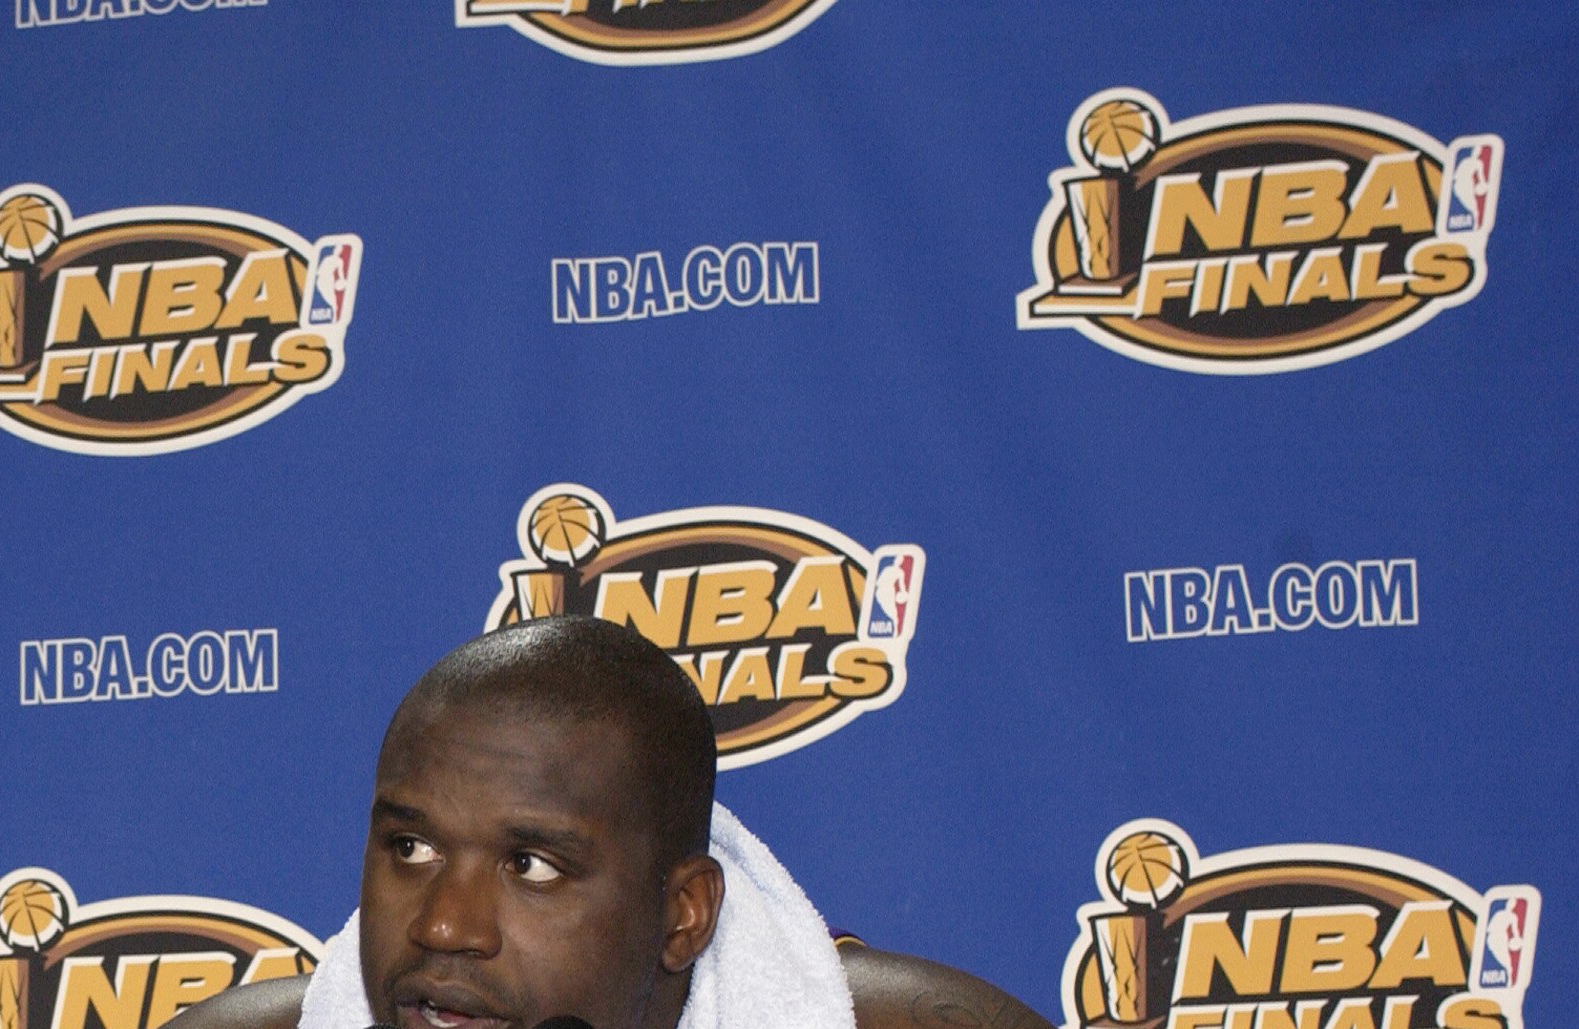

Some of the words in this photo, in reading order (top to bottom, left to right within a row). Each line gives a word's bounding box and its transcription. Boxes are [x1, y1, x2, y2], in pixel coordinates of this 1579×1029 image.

[1144, 150, 1435, 261] NBA
[45, 248, 299, 349] NBA
[551, 242, 820, 323] NBA.COM
[1132, 242, 1472, 320] FINALS
[33, 333, 330, 406] FINALS
[1124, 558, 1419, 642] NBA.COM
[21, 628, 279, 705] NBA.COM
[1170, 899, 1467, 1006] NBA
